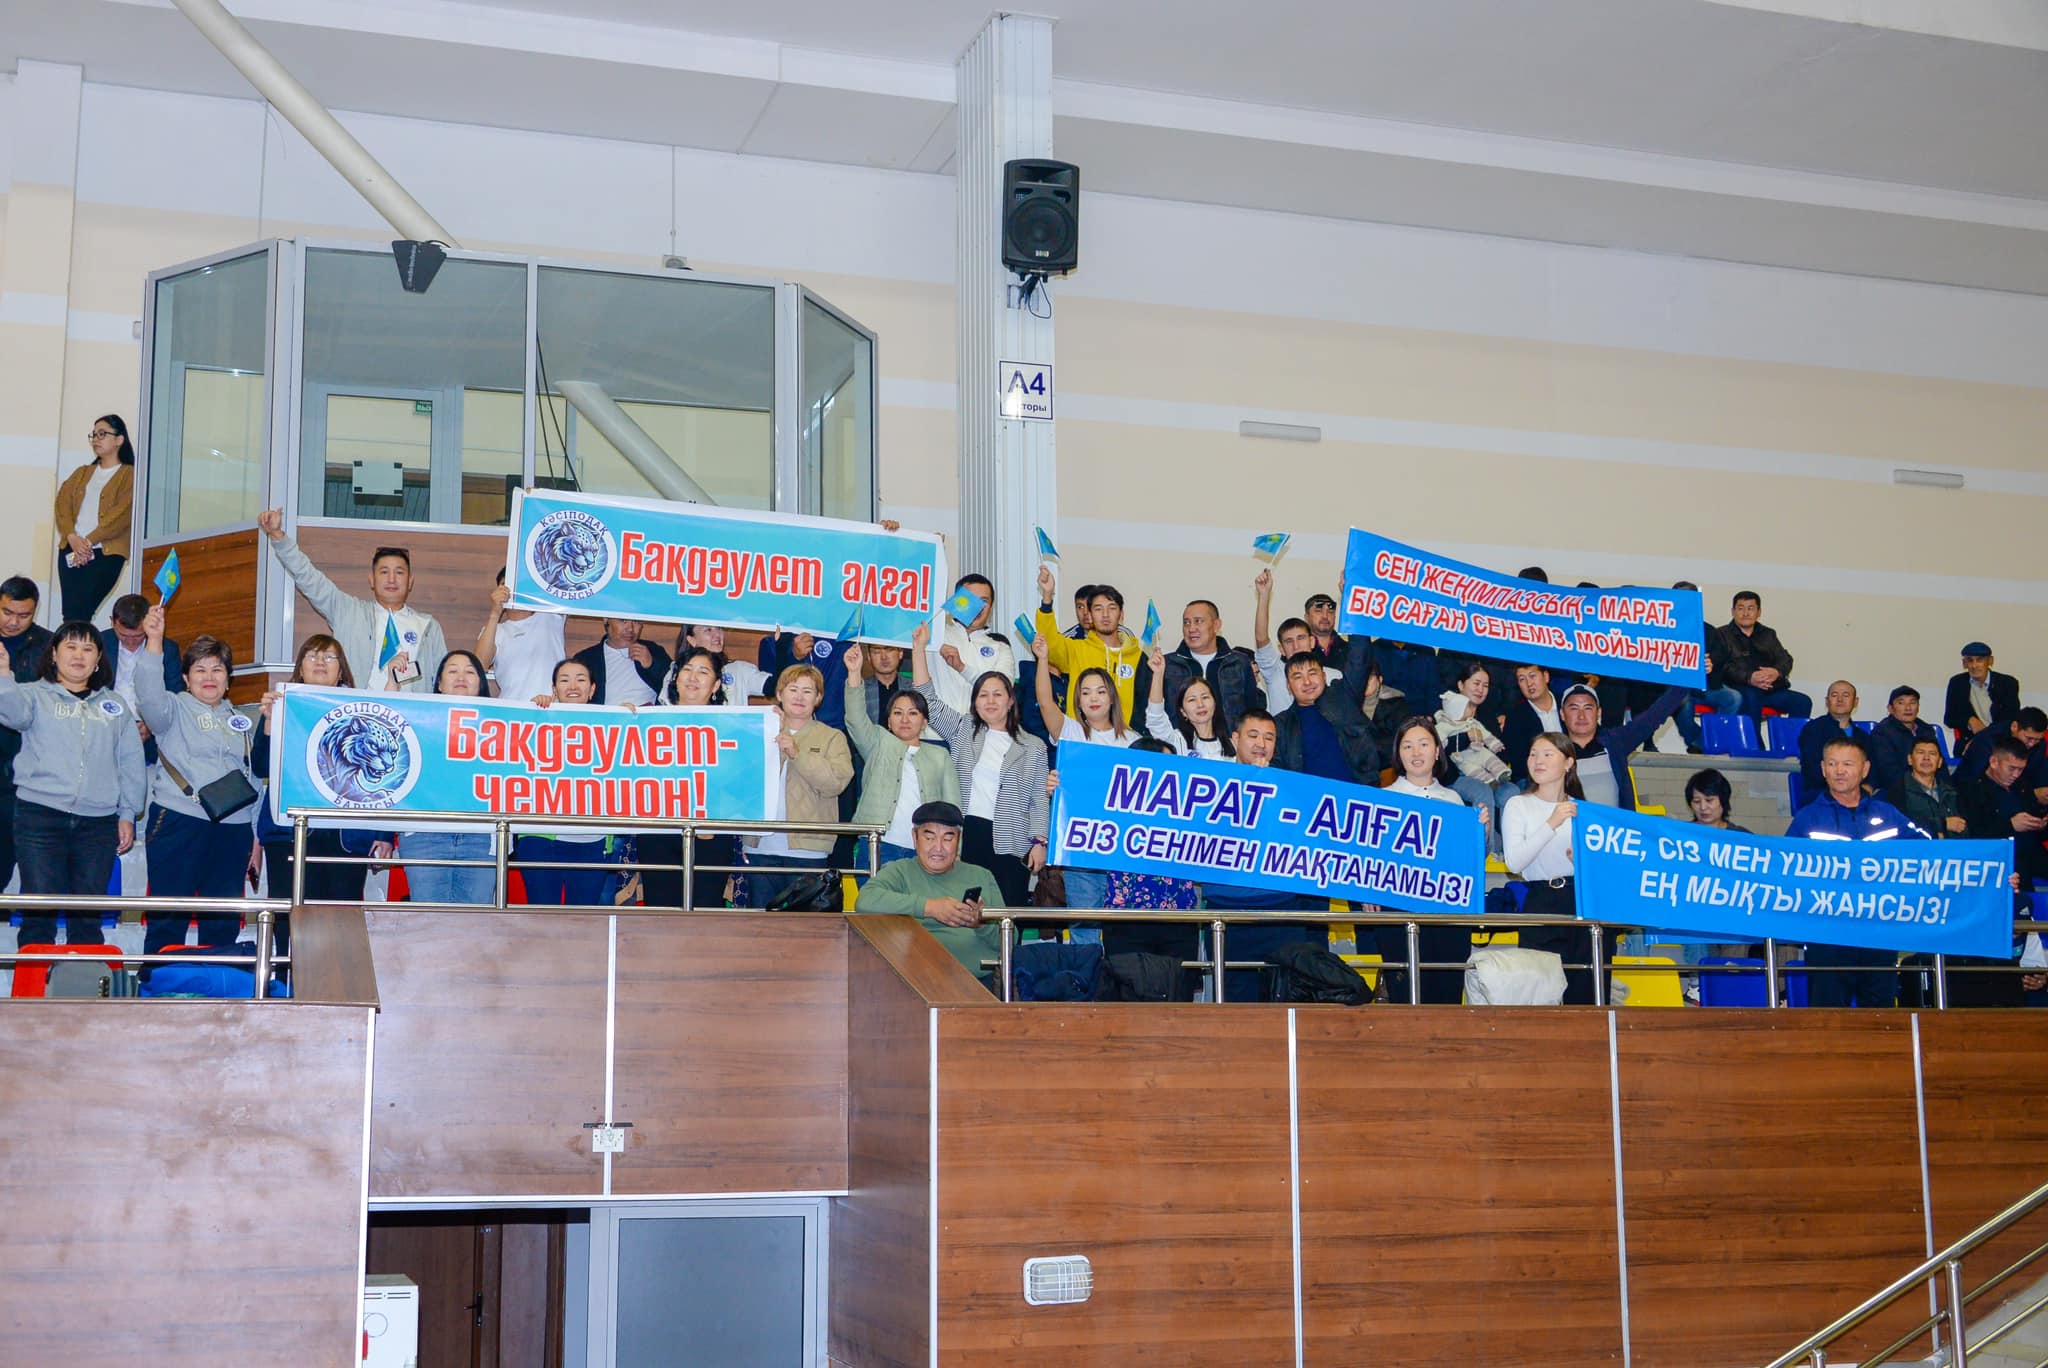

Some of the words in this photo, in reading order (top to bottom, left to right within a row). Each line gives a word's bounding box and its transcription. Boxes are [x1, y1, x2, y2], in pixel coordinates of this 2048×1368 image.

[545, 584, 594, 600] БАРЫСЫ
[620, 531, 822, 598] Бақдәулет
[1376, 552, 1420, 585] СЕН
[1422, 565, 1585, 622] ЖЕҢІМПАЗСЫҢ
[1599, 596, 1675, 627] МАРАТ.
[1349, 588, 1387, 616] БІЗ
[1392, 596, 1467, 631] САҒАН
[1473, 616, 1572, 649] СЕНЕМІЗ.
[1576, 630, 1699, 670] МОЙЫНҚҰМ
[447, 709, 737, 773] Бақдәулет-
[475, 771, 706, 818] чемпион!
[1106, 767, 1274, 827] МАРАТ
[1281, 808, 1299, 822] -
[1309, 797, 1441, 858] АЛҒА!
[1066, 820, 1115, 852] БІЗ
[1126, 828, 1259, 870] СЕНІМЕН
[1263, 844, 1472, 904] МАҚТАНАМЫЗ!
[1585, 823, 1647, 862] ӘКЕ,
[1658, 837, 1701, 863] СІЗ
[1708, 842, 1771, 874] МЕН
[1779, 851, 1851, 880] ҮШІН
[1860, 857, 2005, 892] ӘЛЕМДЕГІ
[1640, 869, 1679, 907] ЕҢ
[1685, 875, 1802, 915] МЫҚТЫ
[1808, 889, 1950, 925] ЖАНСЫЗ!
